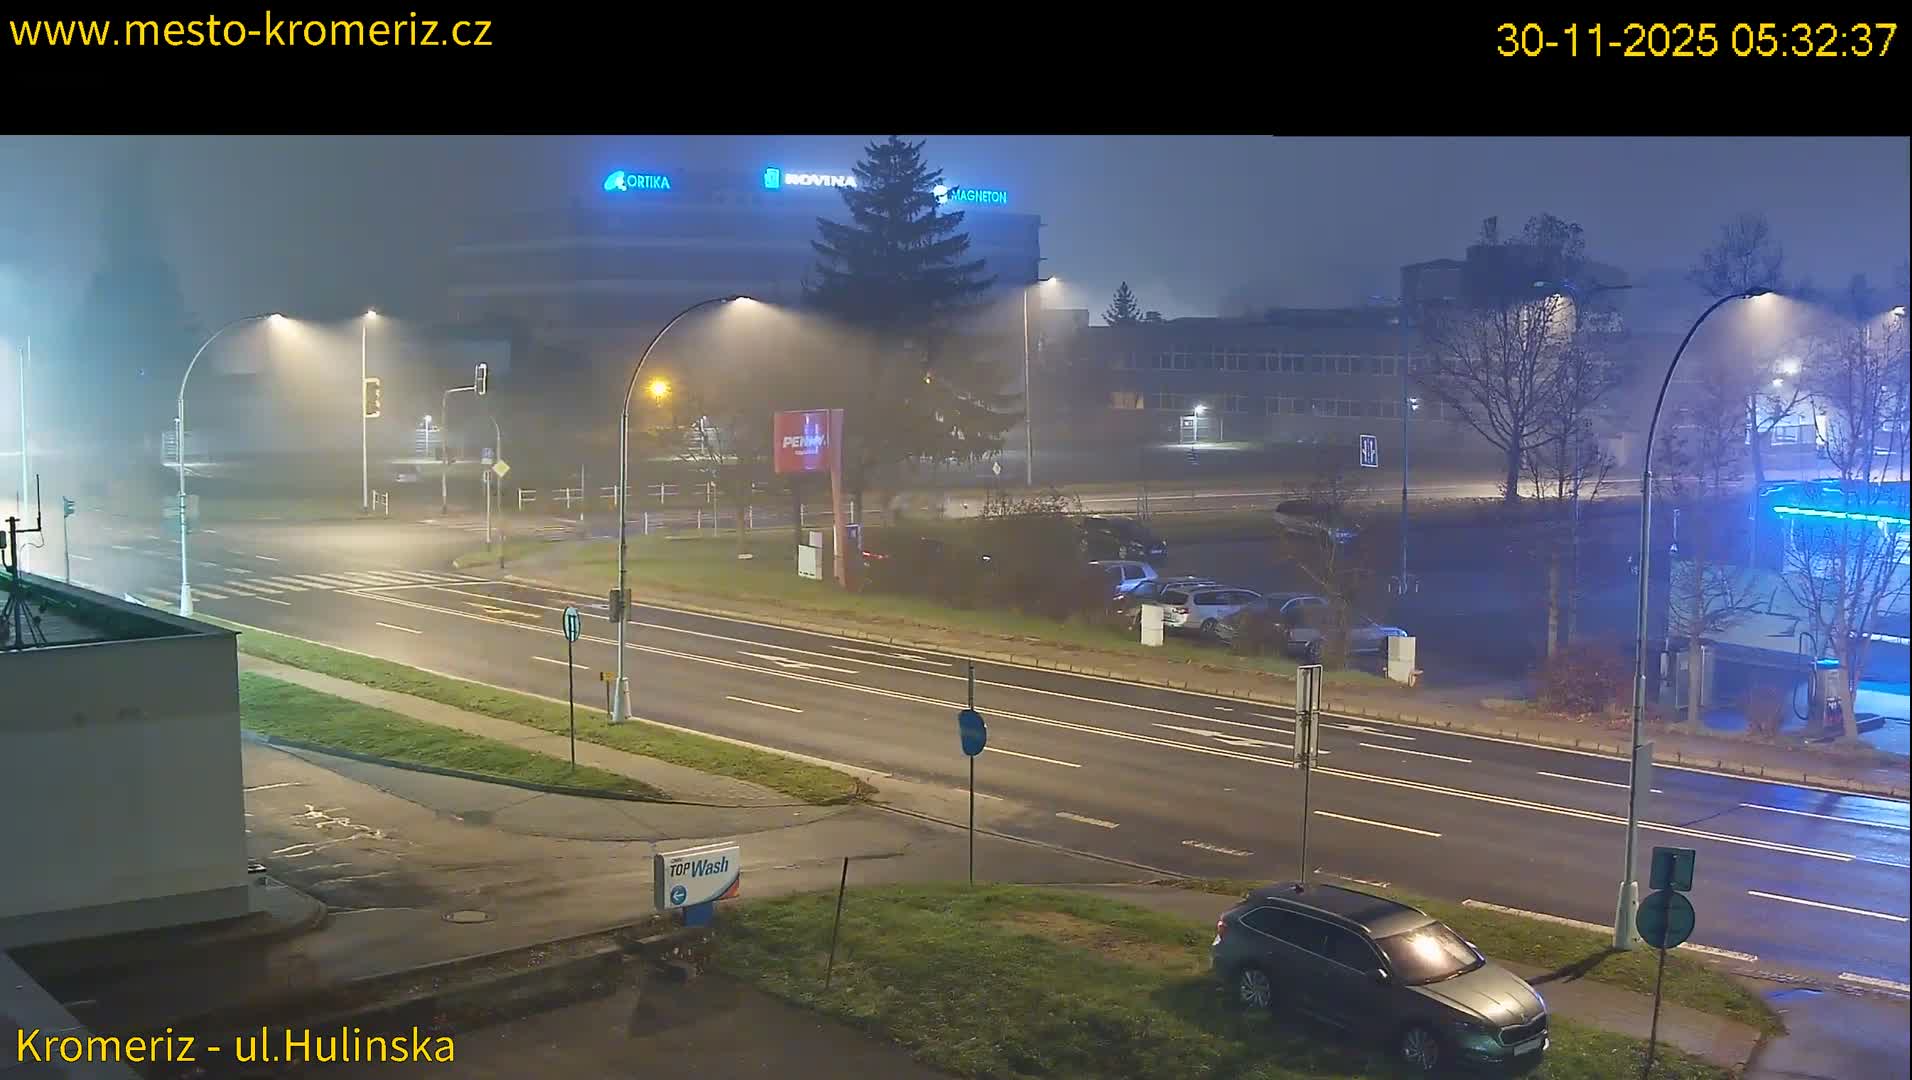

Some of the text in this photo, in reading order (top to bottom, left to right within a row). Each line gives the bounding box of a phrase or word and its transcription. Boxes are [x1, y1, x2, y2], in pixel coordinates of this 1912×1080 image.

[627, 174, 671, 189] ORTIKA
[784, 173, 858, 188] ROVINA
[951, 188, 1007, 204] MAGNETON
